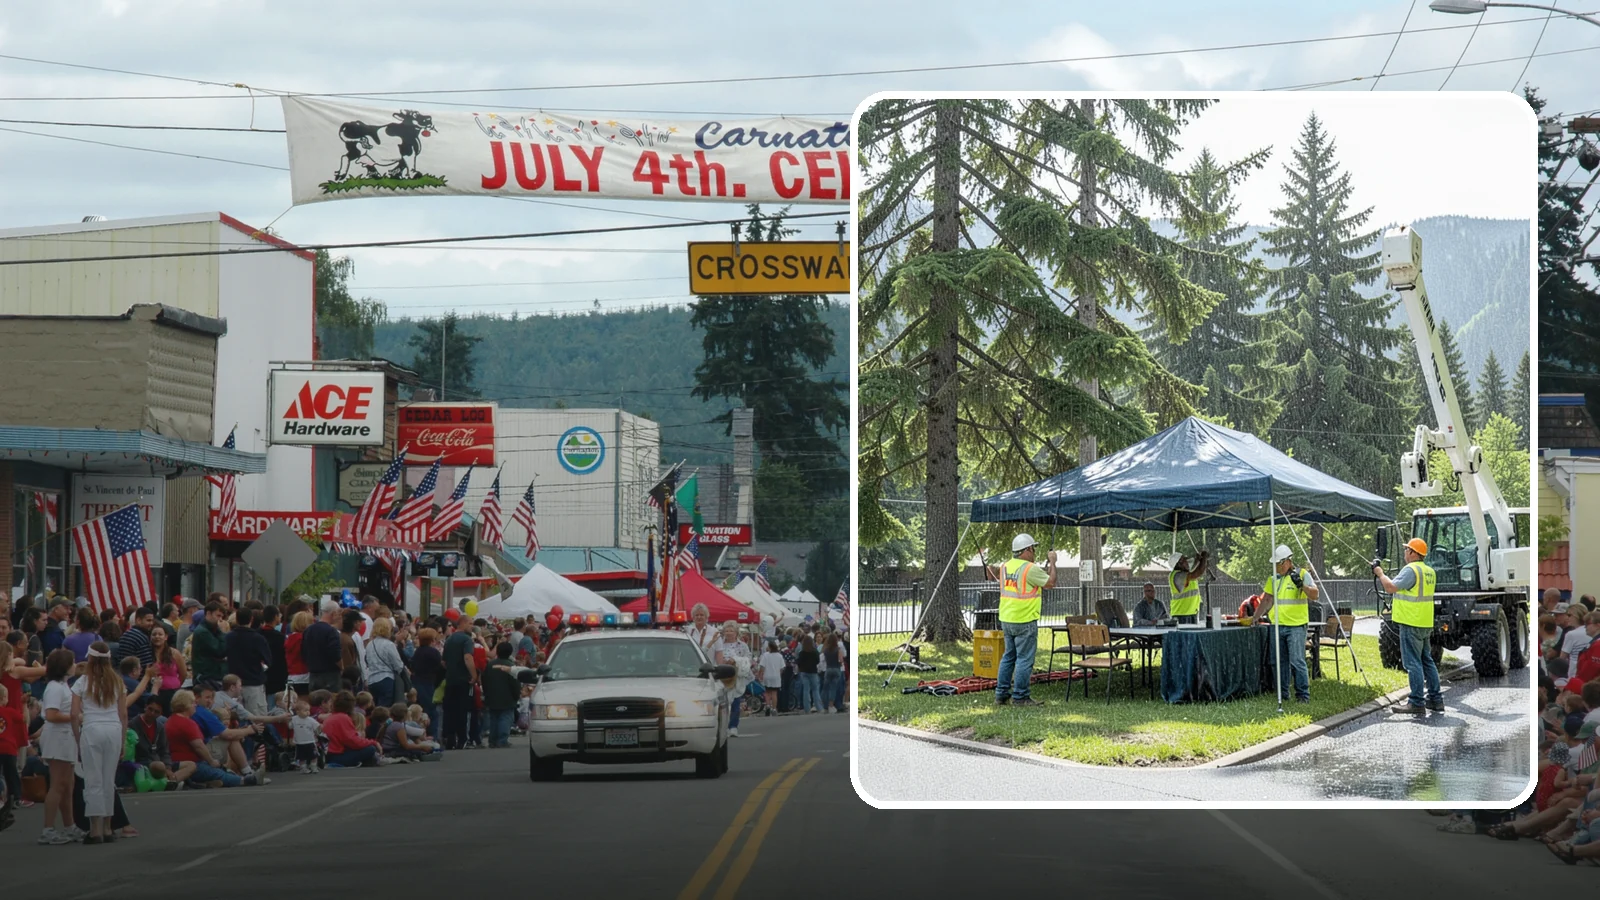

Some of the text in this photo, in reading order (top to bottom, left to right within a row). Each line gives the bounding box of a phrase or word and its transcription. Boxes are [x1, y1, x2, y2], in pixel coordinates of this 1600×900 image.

[481, 141, 605, 192] JULY
[632, 150, 746, 198] 4th.
[697, 254, 850, 280] CROSSWA
[282, 380, 374, 420] ACE
[405, 409, 452, 422] CEDAR
[283, 421, 371, 436] Hardware
[353, 466, 387, 481] Simpl
[83, 484, 155, 496] St. Vincent de Paul
[688, 526, 741, 535] CRNATION
[699, 535, 730, 543] GLASS
